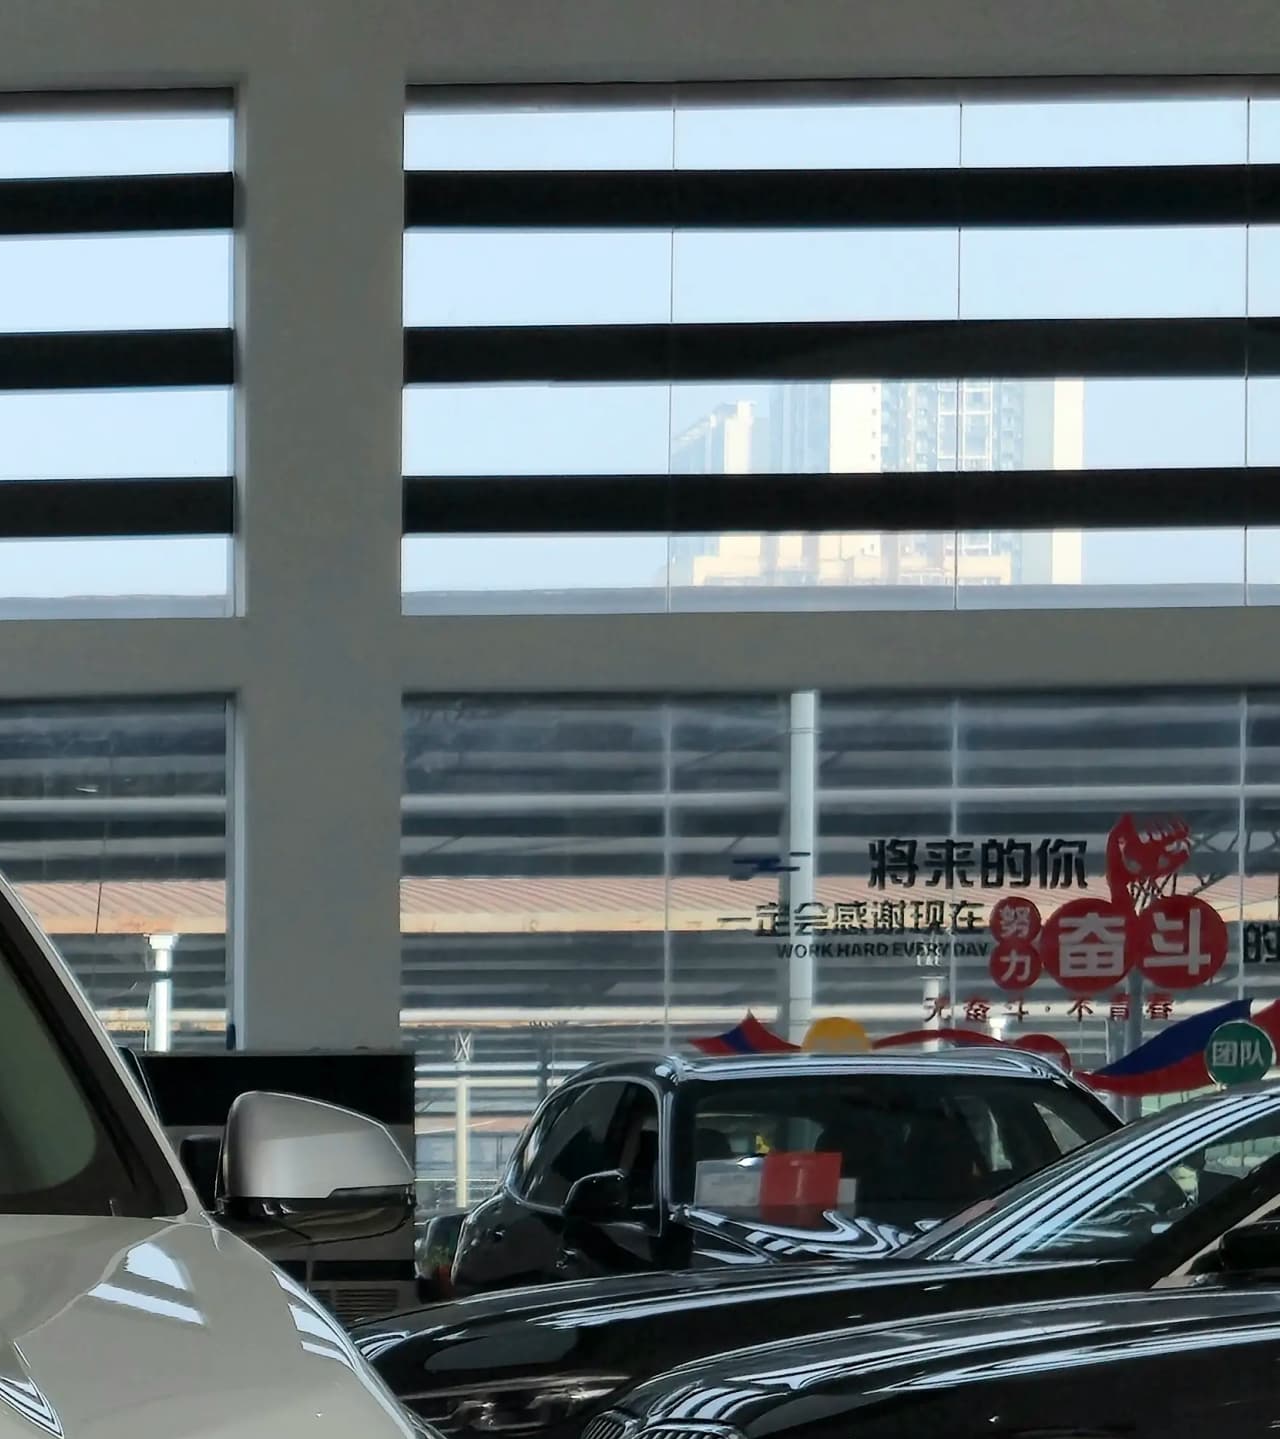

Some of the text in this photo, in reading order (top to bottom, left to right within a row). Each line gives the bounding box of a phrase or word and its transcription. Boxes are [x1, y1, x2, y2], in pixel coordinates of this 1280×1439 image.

[867, 838, 1088, 890] 将来的你
[717, 900, 986, 937] 一定会感谢现在
[998, 905, 1033, 981] 努力
[1056, 908, 1212, 977] 奋斗
[777, 942, 989, 959] WORK HARD EVERY DAY
[1212, 1039, 1264, 1067] 团队
